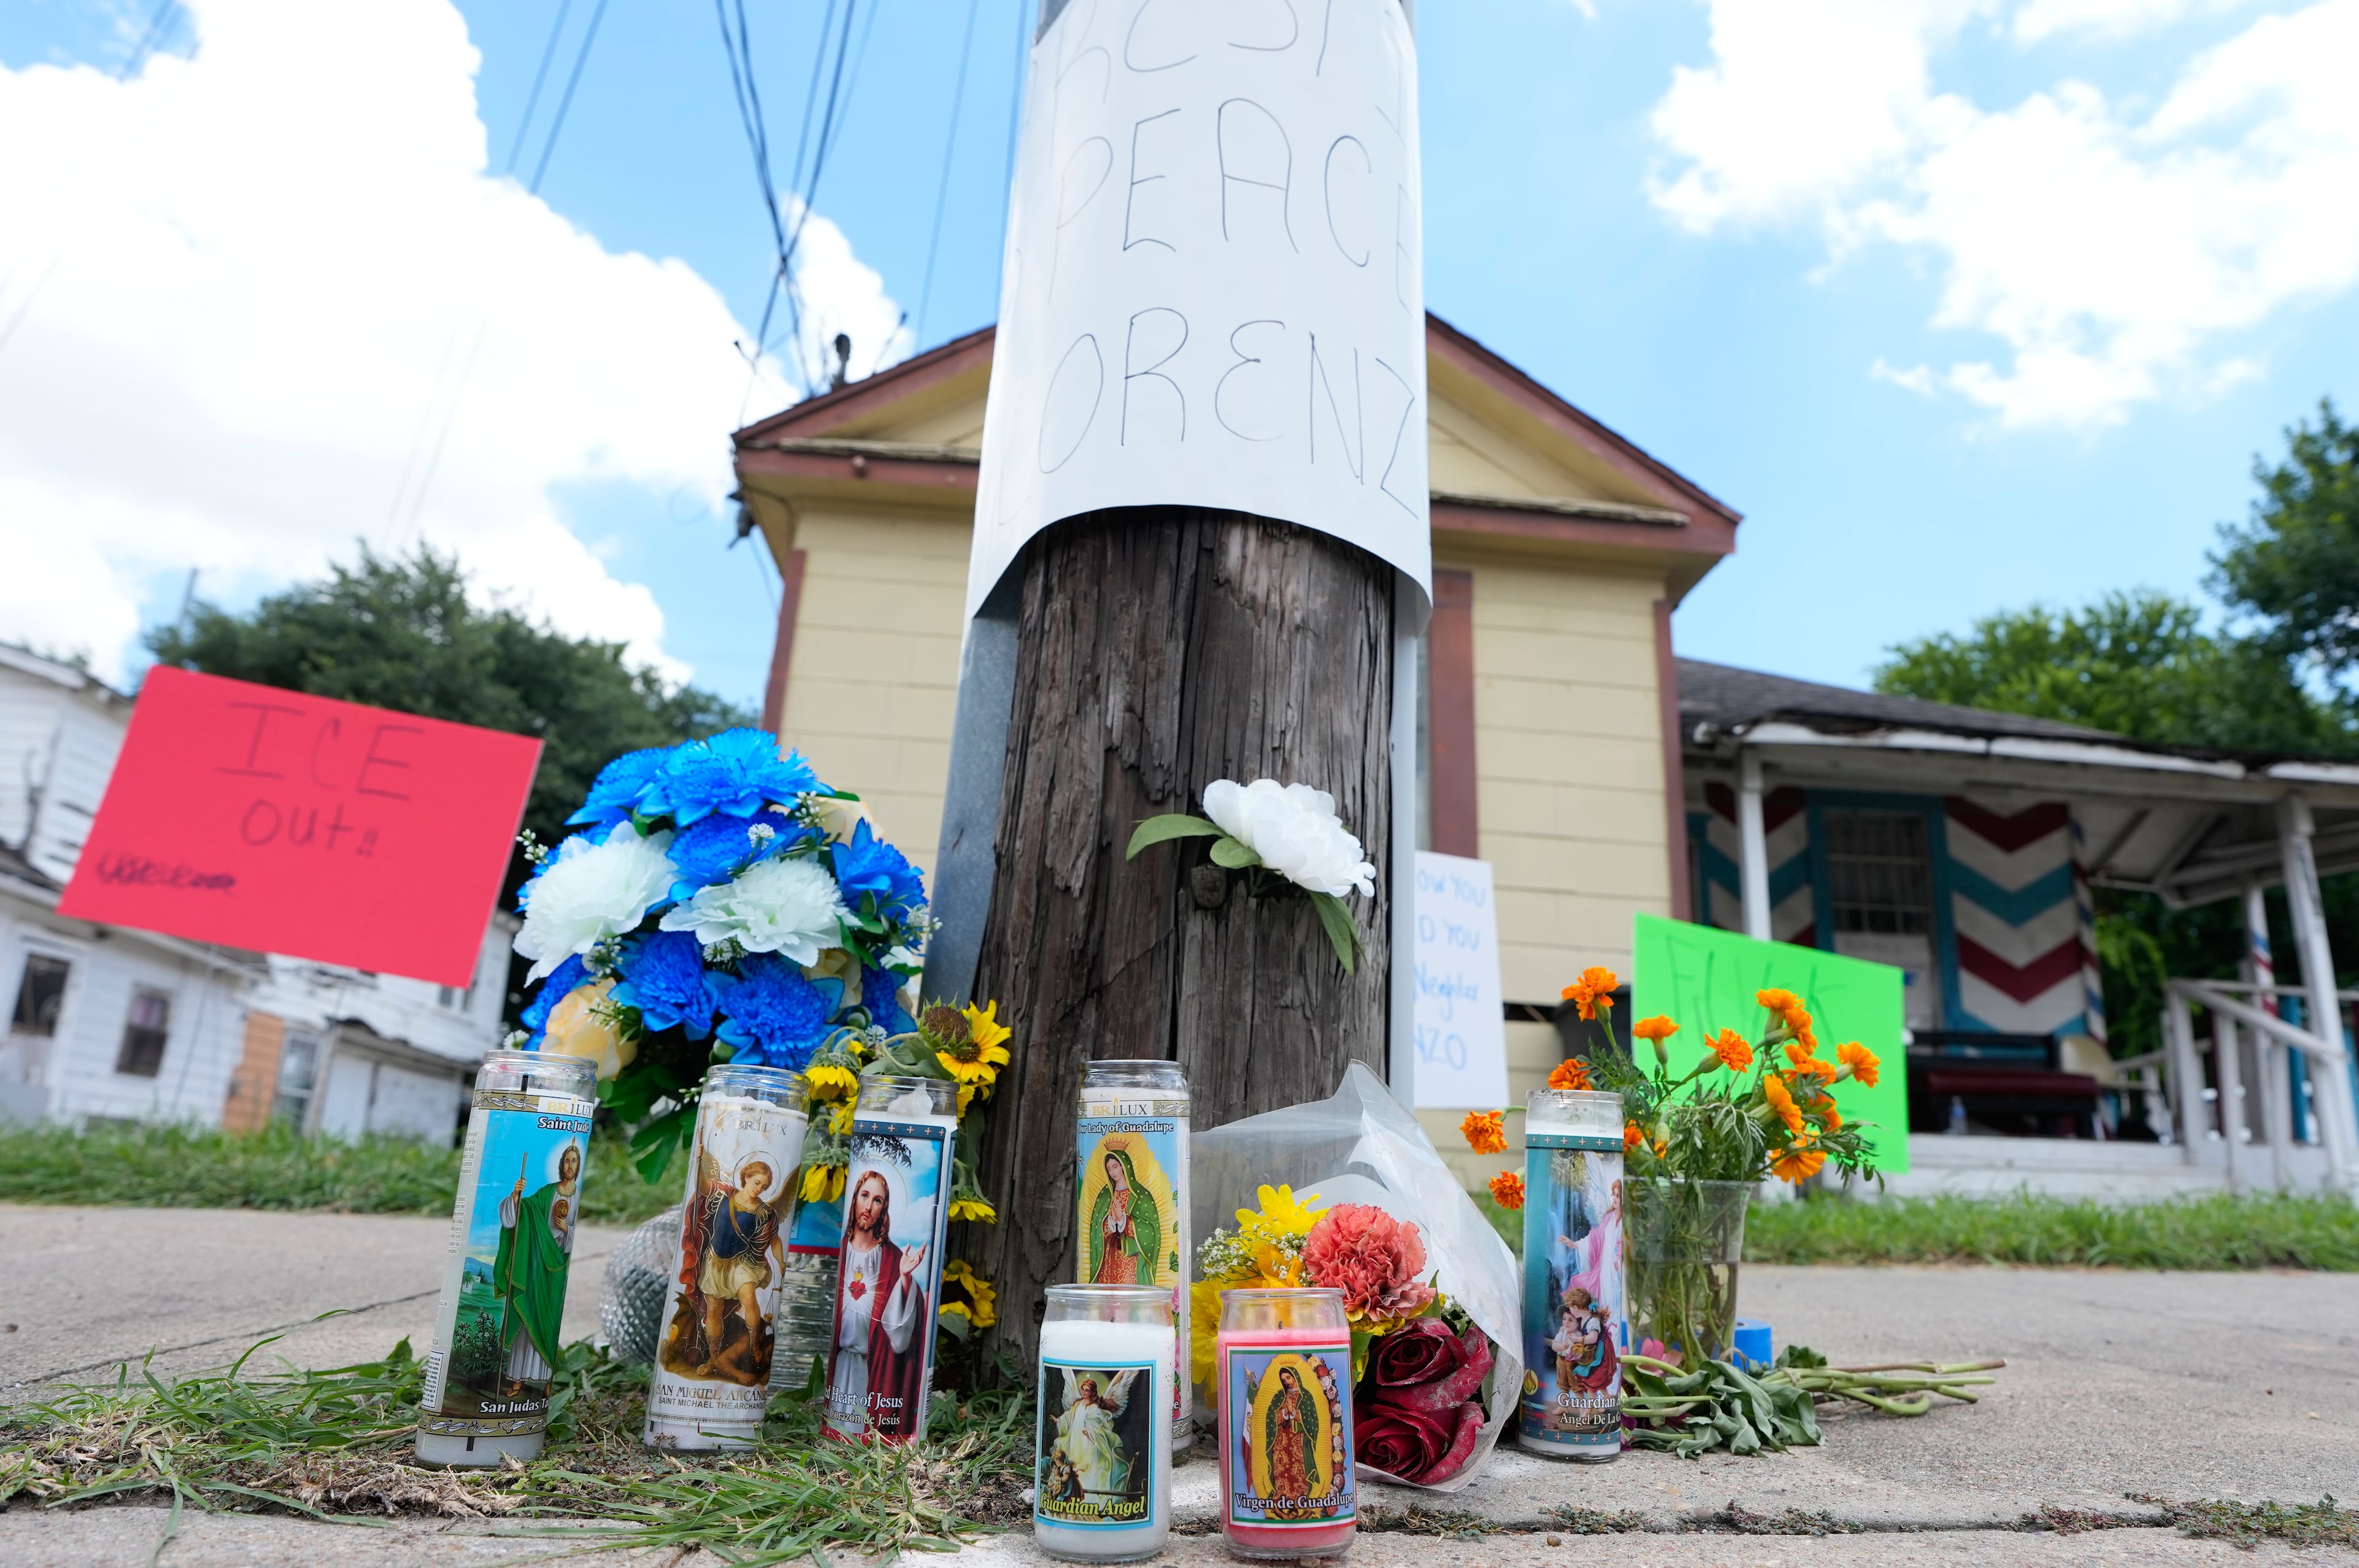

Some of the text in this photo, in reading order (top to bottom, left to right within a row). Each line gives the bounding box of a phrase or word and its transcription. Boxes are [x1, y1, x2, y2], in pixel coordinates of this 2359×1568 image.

[216, 701, 426, 801] ICE
[1664, 934, 1847, 1048] FUK
[538, 1116, 590, 1134] Saint Jude
[1088, 1122, 1107, 1135] Lady
[1108, 1121, 1121, 1132] of
[1122, 1121, 1174, 1134] Guadalupe
[656, 1384, 674, 1396] SAN
[676, 1386, 721, 1401] MIGUEL
[831, 1386, 858, 1405] Heart
[859, 1392, 874, 1407] of
[874, 1392, 904, 1411] Jesus
[1557, 1392, 1615, 1409] Guardian
[480, 1401, 507, 1413] San
[508, 1398, 540, 1414] Judas
[678, 1400, 714, 1409] MICHAEL
[830, 1406, 861, 1424] Corazón
[863, 1413, 875, 1425] de
[876, 1413, 901, 1427] Jesús
[1559, 1412, 1590, 1428] Angel
[1593, 1413, 1605, 1425] De
[1607, 1413, 1616, 1424] La
[1040, 1492, 1146, 1517] Guardian Angel
[1235, 1491, 1353, 1512] Virgen de Guadalupe
